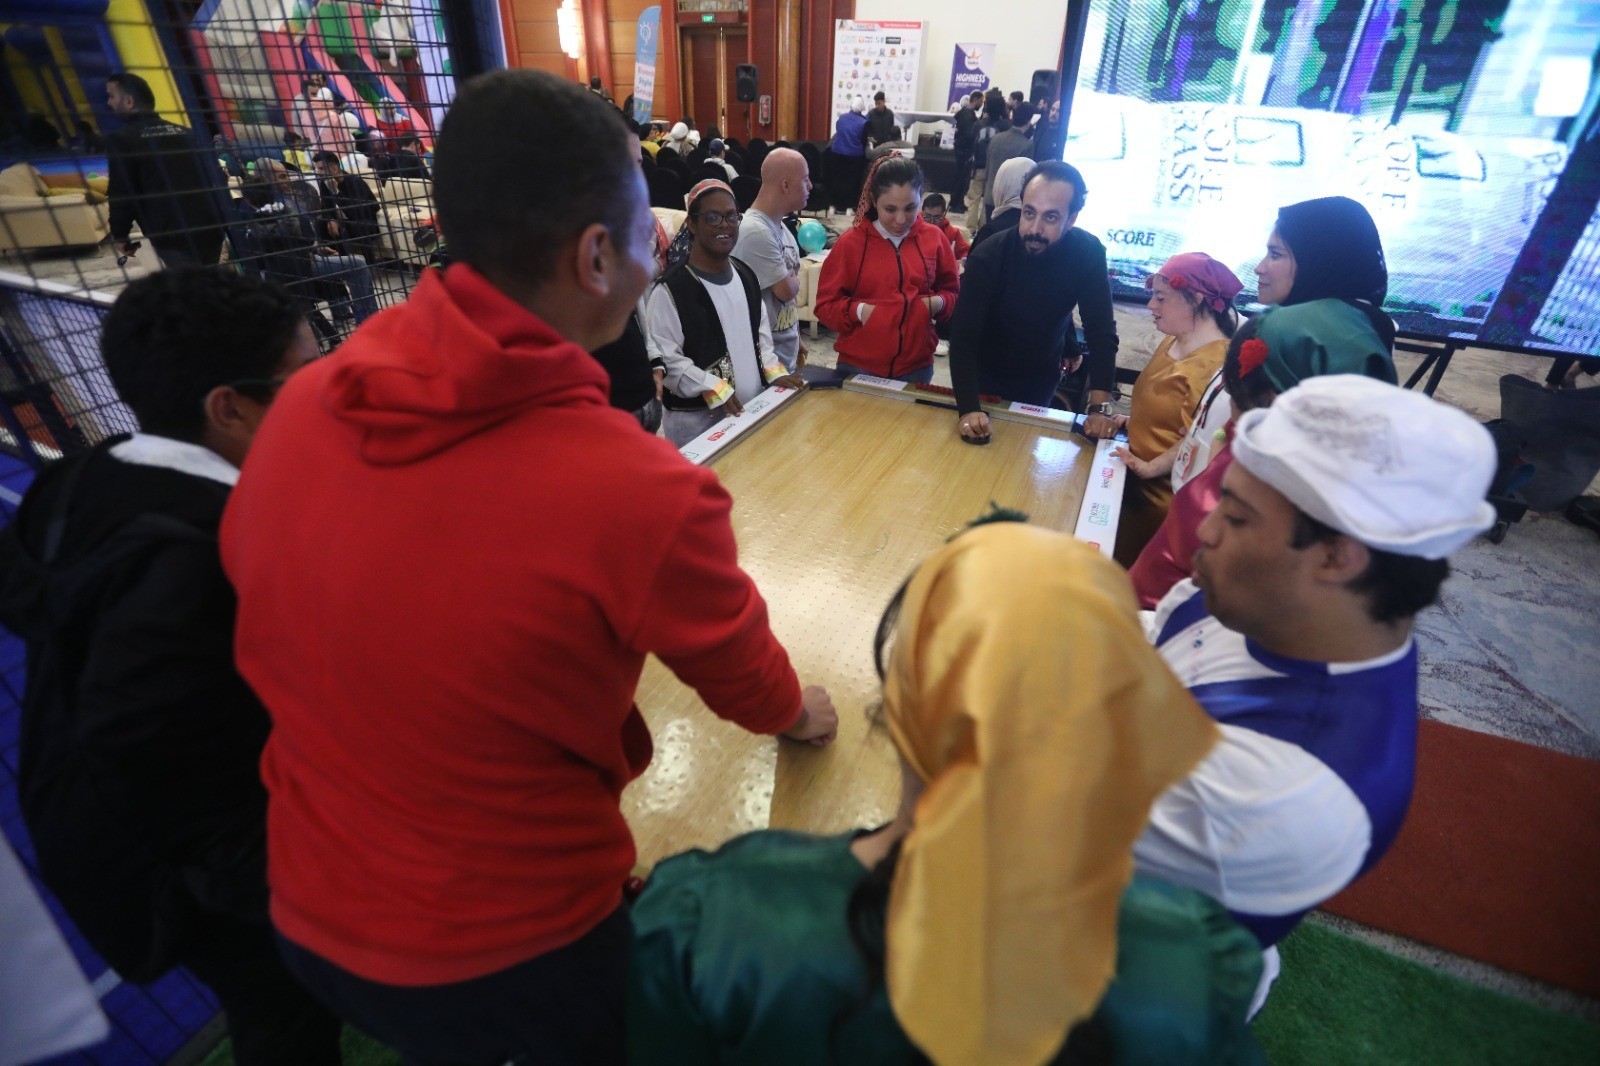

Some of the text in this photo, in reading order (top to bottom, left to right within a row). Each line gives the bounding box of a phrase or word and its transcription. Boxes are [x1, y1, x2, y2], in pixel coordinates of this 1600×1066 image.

[639, 77, 652, 87] Style
[956, 73, 986, 84] HIGHNESS
[1106, 228, 1156, 248] SCORE
